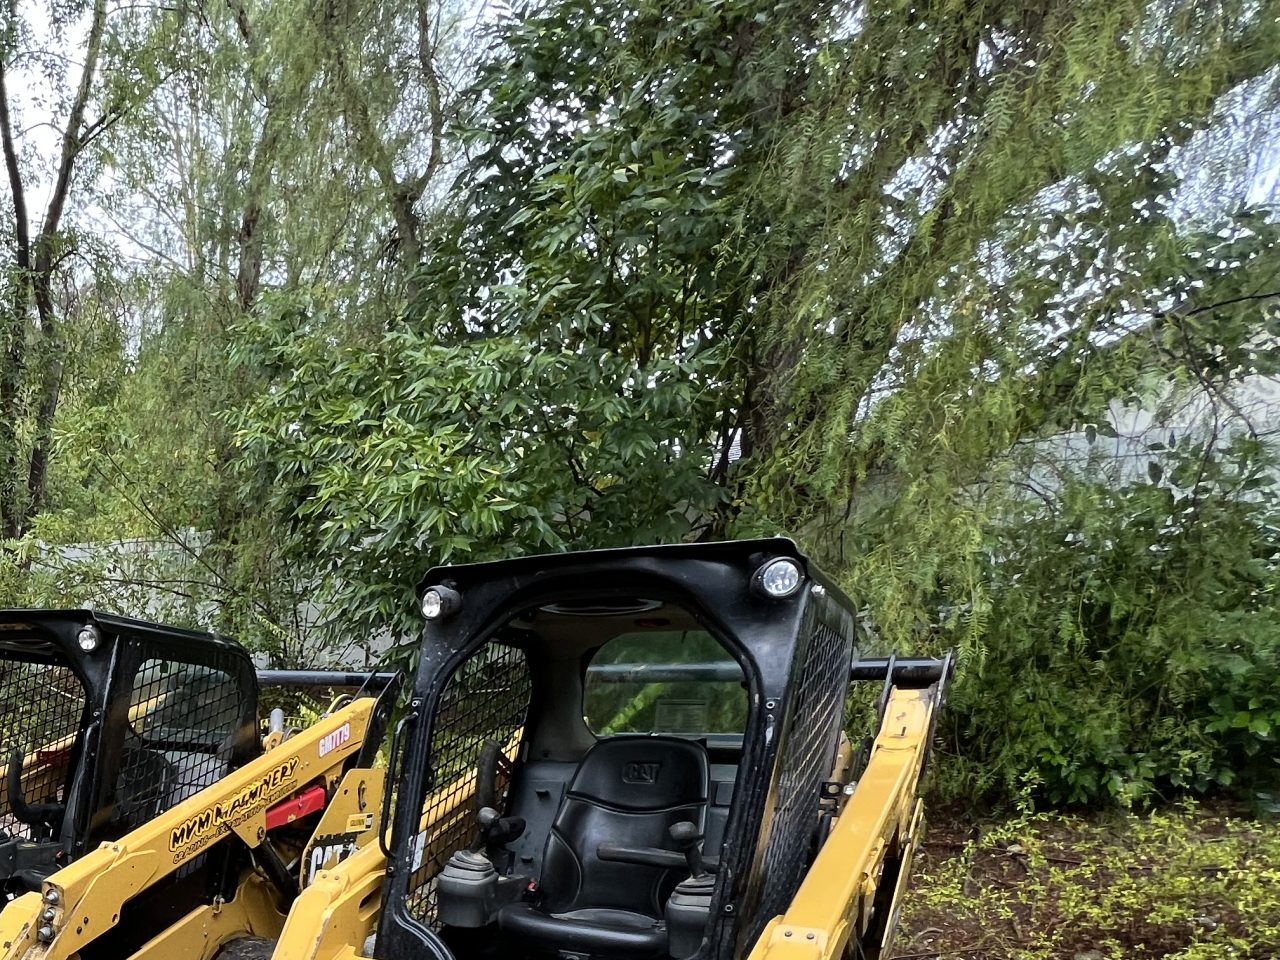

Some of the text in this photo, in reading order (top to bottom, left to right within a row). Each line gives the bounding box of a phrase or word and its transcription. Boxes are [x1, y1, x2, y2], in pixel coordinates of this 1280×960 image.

[622, 763, 660, 785] CAT
[170, 757, 299, 850] MVM MACHINERY
[308, 844, 344, 883] CAT
